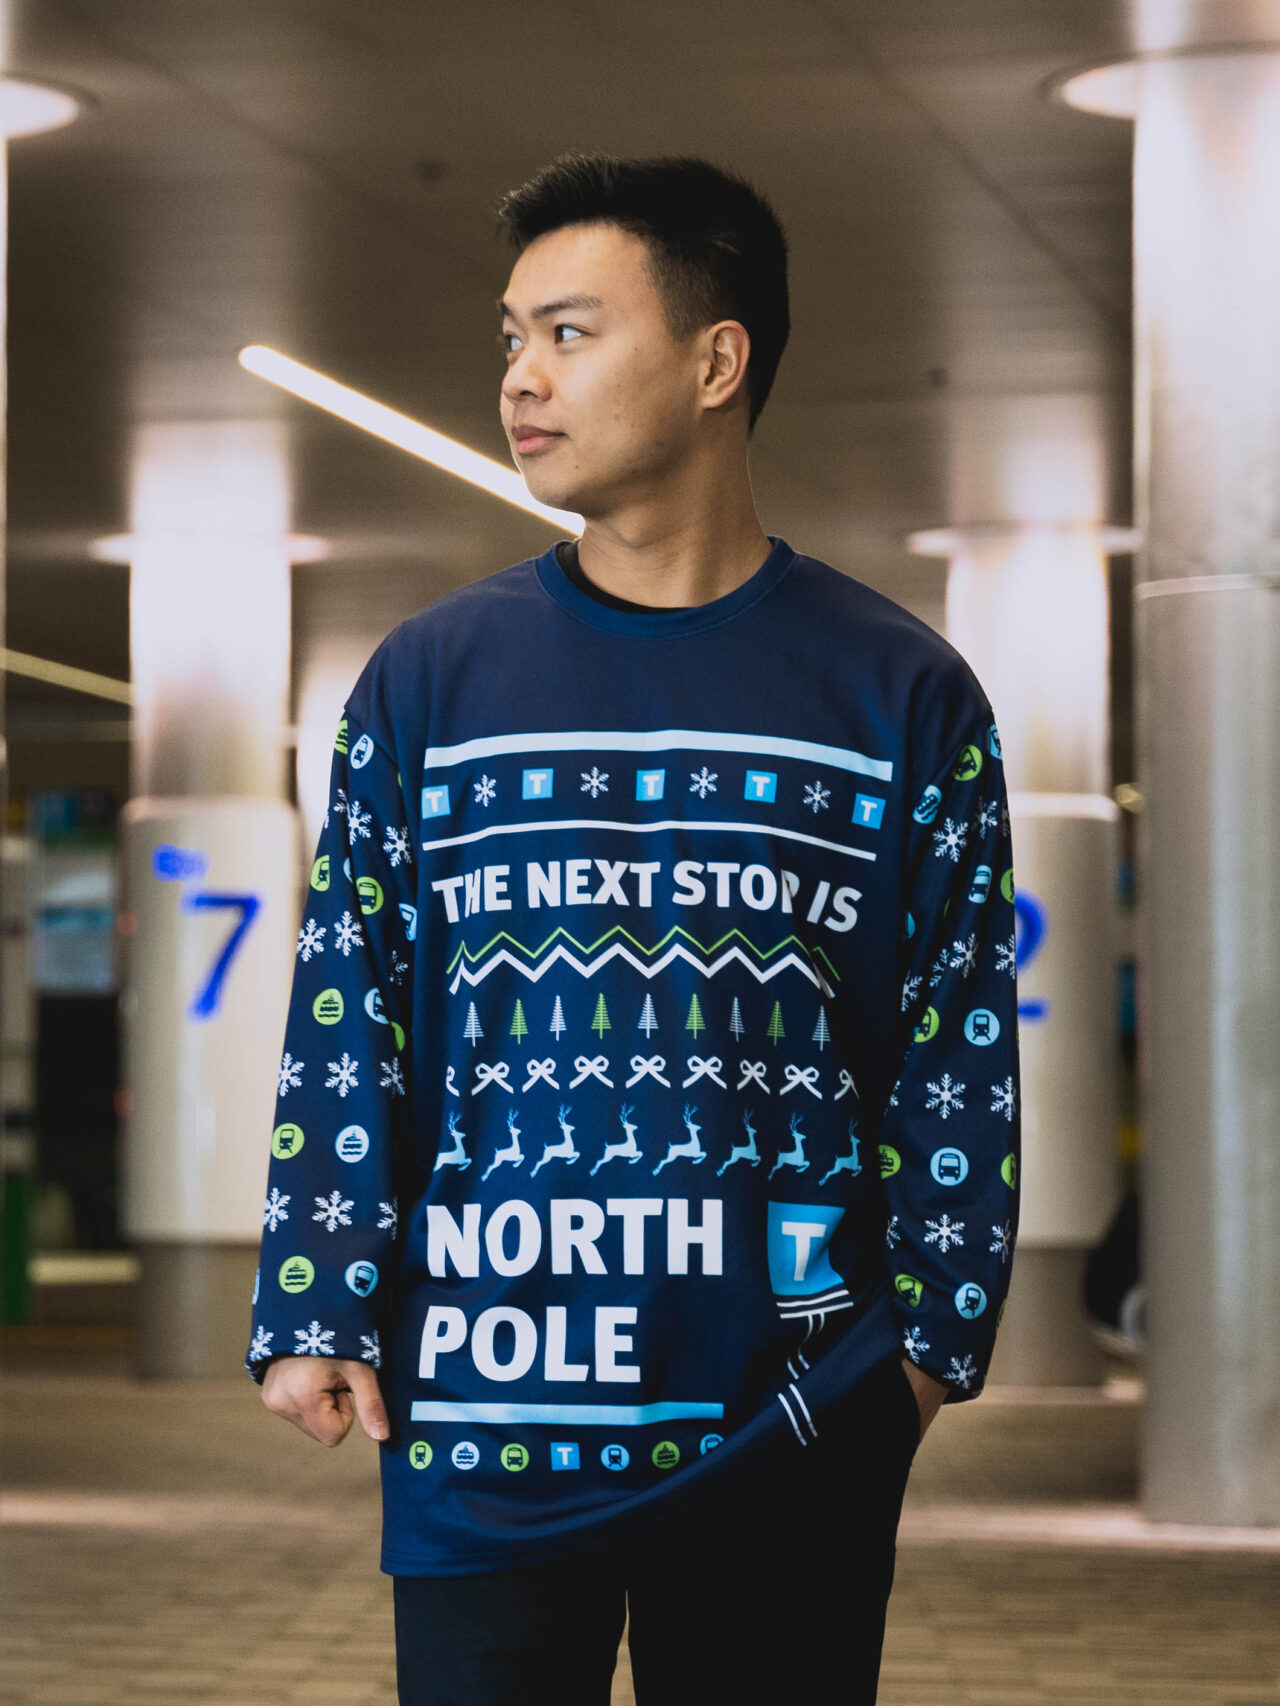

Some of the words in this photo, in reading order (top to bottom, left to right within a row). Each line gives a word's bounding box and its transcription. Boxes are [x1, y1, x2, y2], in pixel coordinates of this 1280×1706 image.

[426, 790, 443, 813] T
[529, 773, 548, 794] T
[642, 774, 661, 797] T
[752, 776, 771, 797] T
[860, 801, 878, 822] T
[431, 864, 512, 924] THE
[526, 859, 661, 909] NEXT
[671, 860, 800, 914] STOP
[806, 881, 864, 933] IS
[186, 892, 261, 1020] 7
[426, 1198, 723, 1278] NORTH
[782, 1221, 826, 1281] T
[418, 1305, 641, 1383] POLE
[557, 1446, 573, 1466] T
